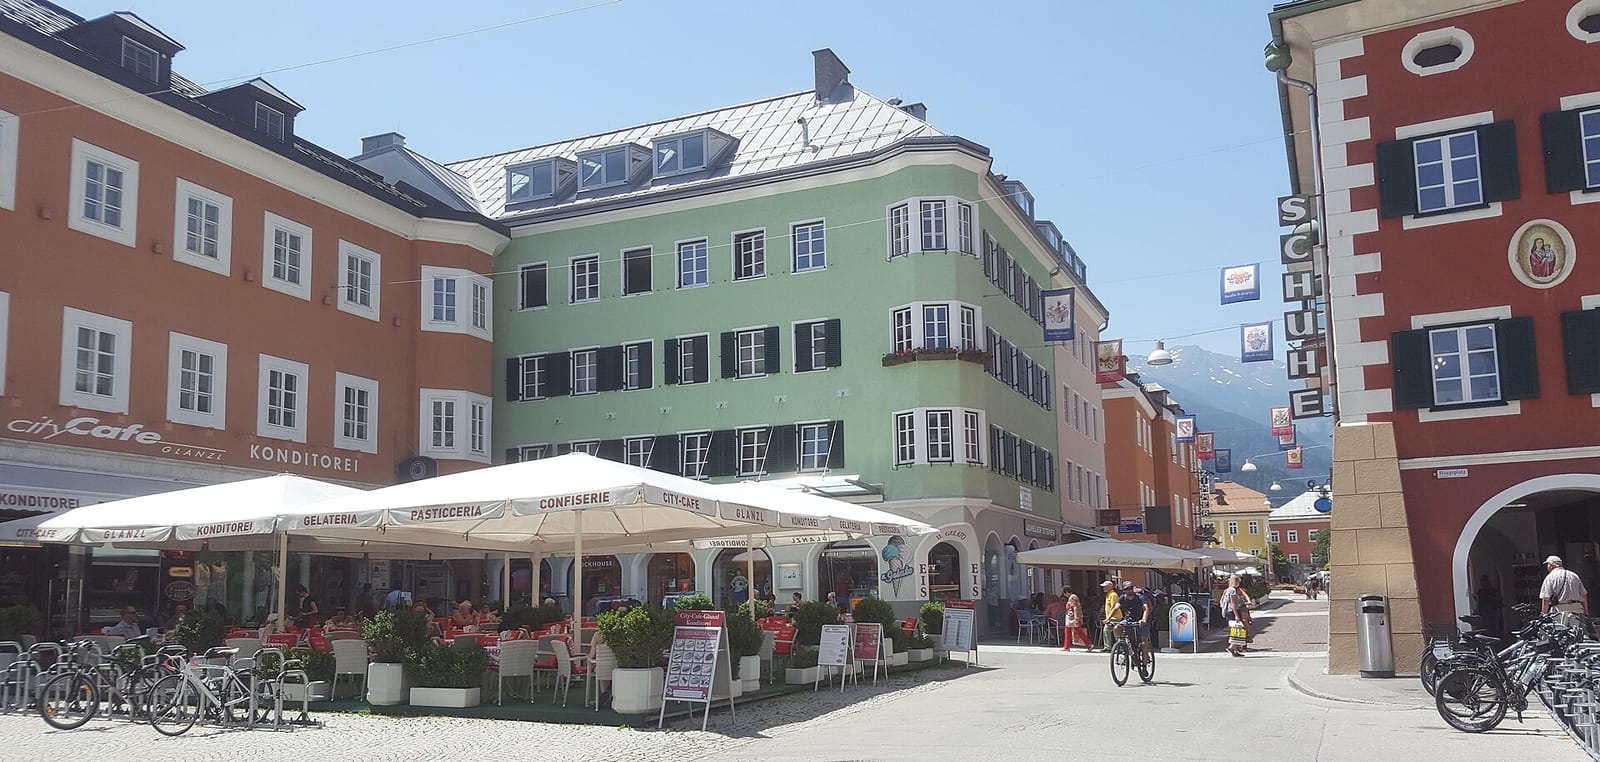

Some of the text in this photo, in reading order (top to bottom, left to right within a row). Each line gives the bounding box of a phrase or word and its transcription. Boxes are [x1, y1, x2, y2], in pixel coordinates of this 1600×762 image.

[1281, 196, 1322, 417] SCHUHE
[161, 446, 223, 461] GLANZL
[250, 444, 359, 473] KONDITOREI
[0, 493, 80, 509] KONDITOREI
[539, 491, 611, 509] CONFISERIE
[662, 491, 701, 511] CITY-CAFE
[303, 513, 358, 527] GELATERIA
[410, 505, 483, 521] PASTICCERIA
[736, 508, 765, 522] GLANZL
[196, 521, 254, 536] KONDITOREI
[791, 517, 820, 528] KONDITOREI
[839, 520, 862, 531] GELATERIA
[16, 528, 57, 538] CITY-CAFE
[103, 529, 147, 540] GLANZL
[920, 563, 928, 598] EIS
